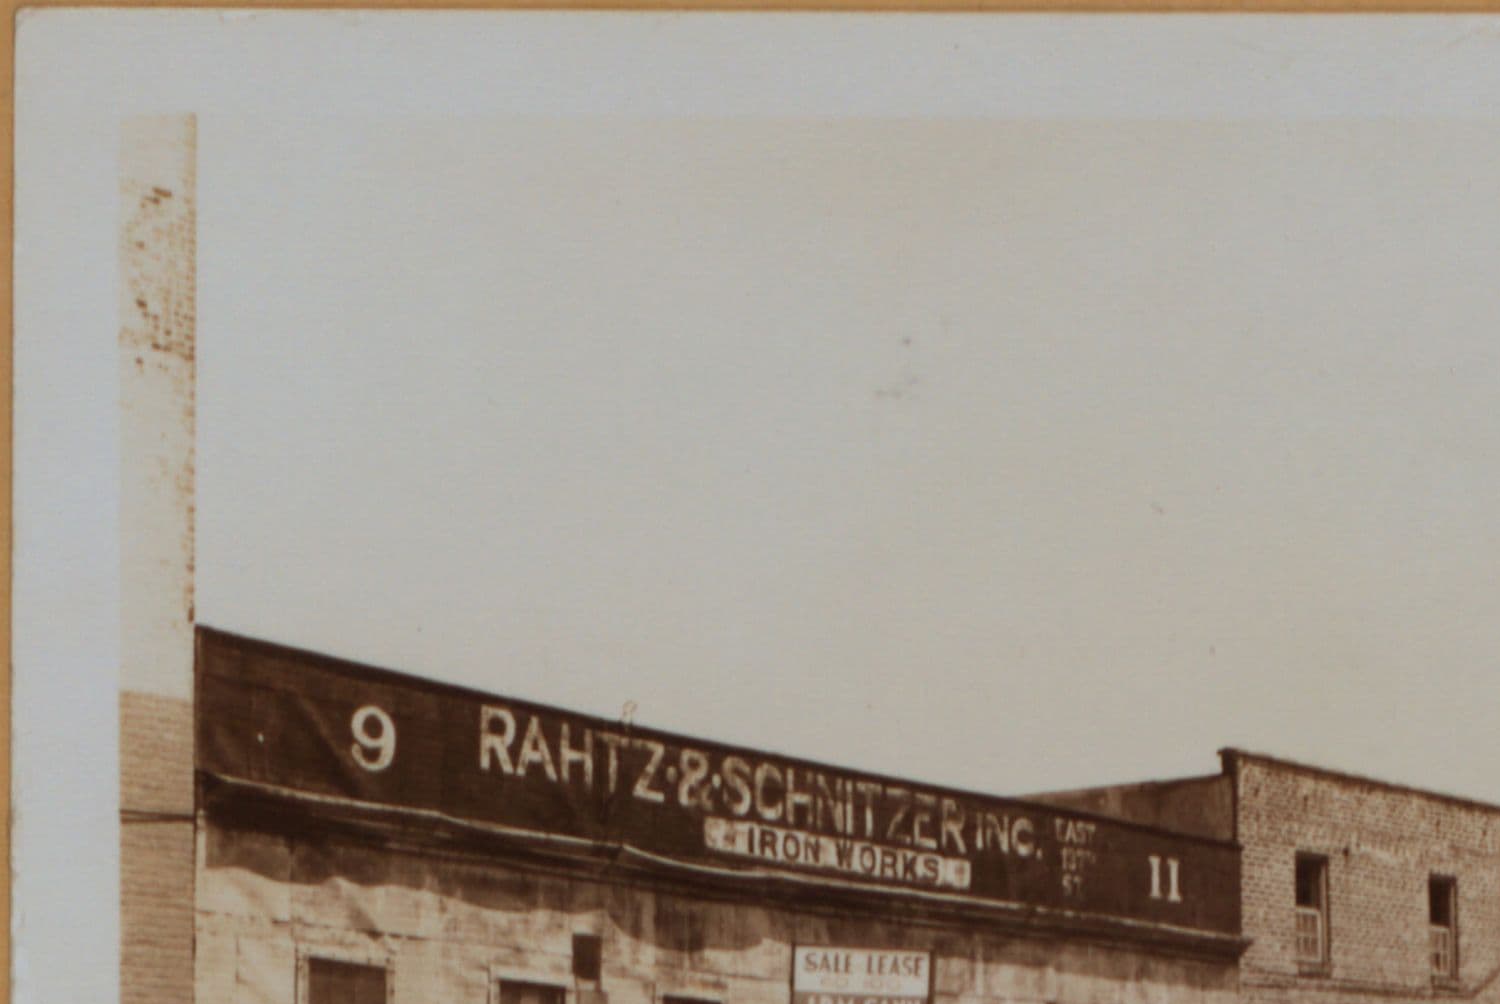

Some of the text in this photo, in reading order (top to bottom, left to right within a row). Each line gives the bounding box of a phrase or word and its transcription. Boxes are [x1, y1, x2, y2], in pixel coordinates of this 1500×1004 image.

[350, 705, 397, 772] 9
[1055, 817, 1096, 844] EAST
[748, 826, 940, 885] IRON WORKS
[1149, 854, 1183, 902] 11
[803, 951, 925, 977] SALE LEASE
